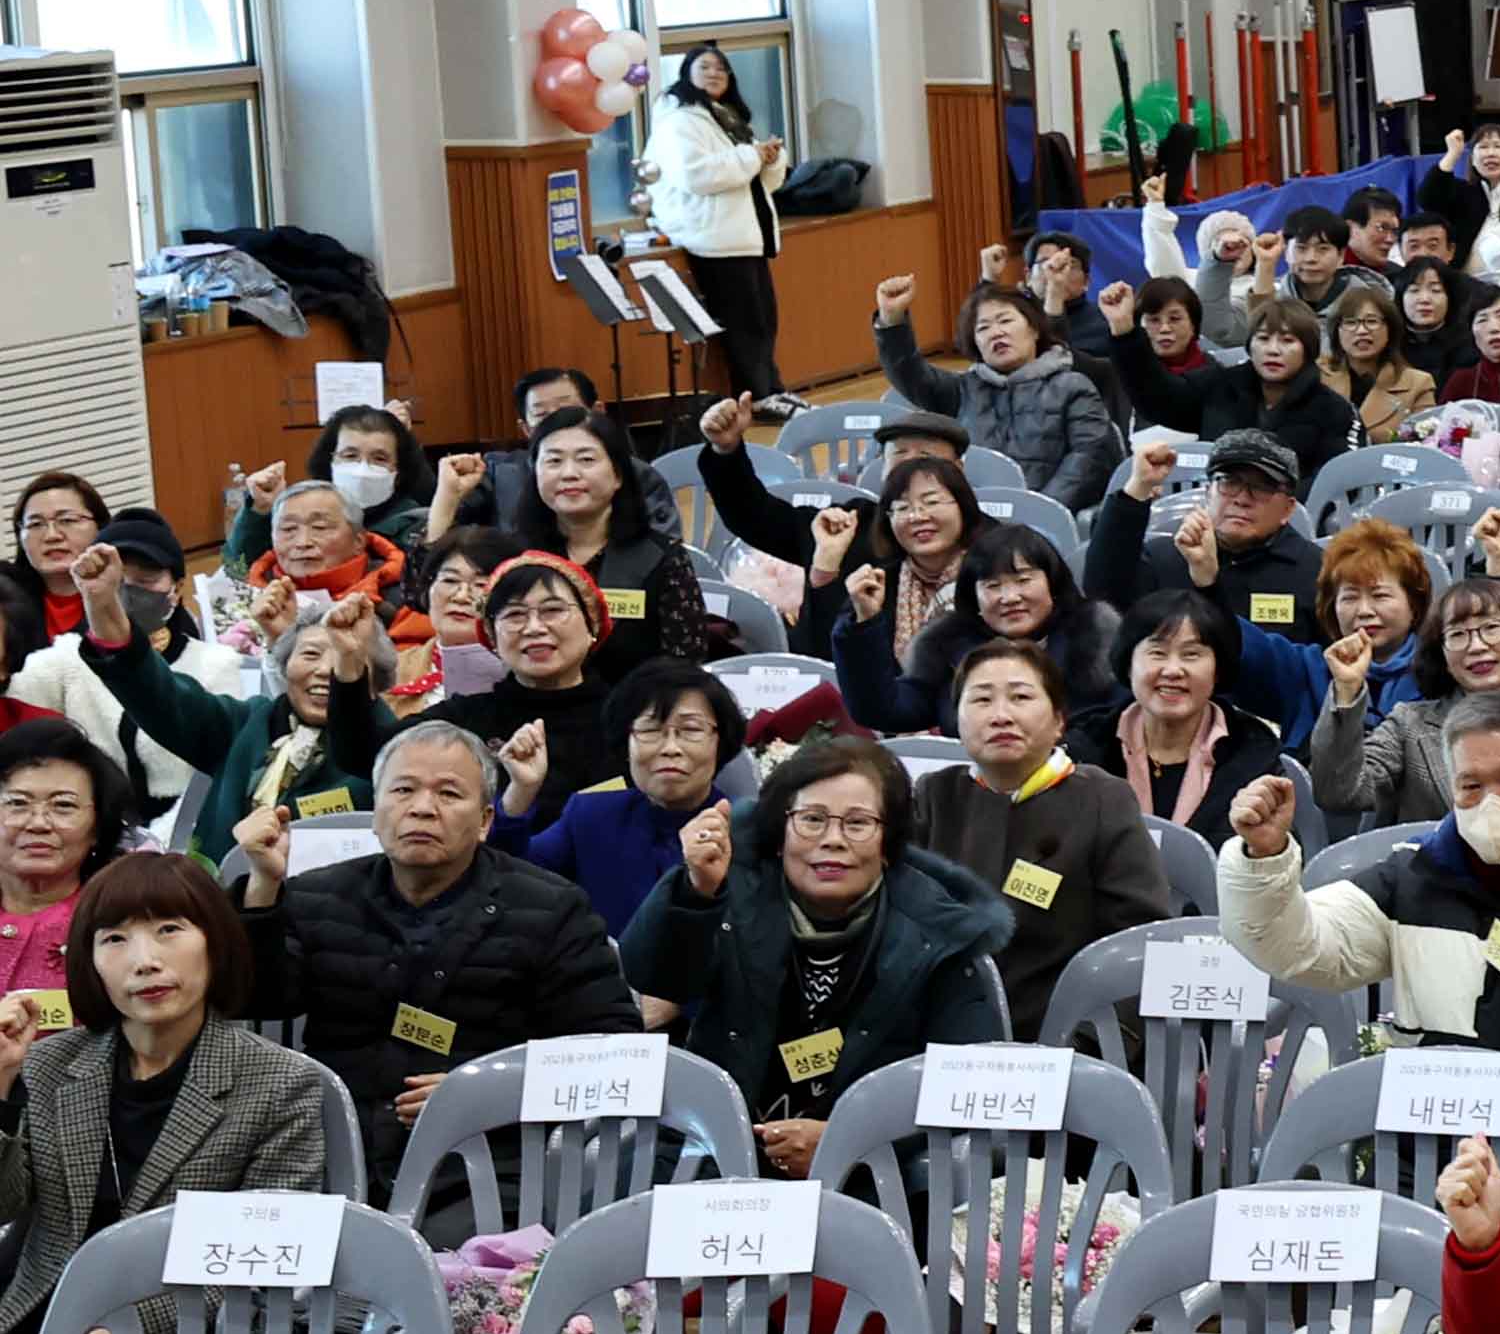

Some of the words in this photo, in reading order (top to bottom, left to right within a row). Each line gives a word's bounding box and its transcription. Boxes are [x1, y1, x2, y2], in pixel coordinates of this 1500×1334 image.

[1168, 983, 1244, 1014] 김준식
[554, 1078, 632, 1114] 내빈석
[950, 1091, 1036, 1122] 내빈석
[1409, 1097, 1493, 1128] 내빈석
[202, 1242, 303, 1277] 장수진
[701, 1233, 766, 1266] 허식
[1247, 1239, 1345, 1273] 심재돈
